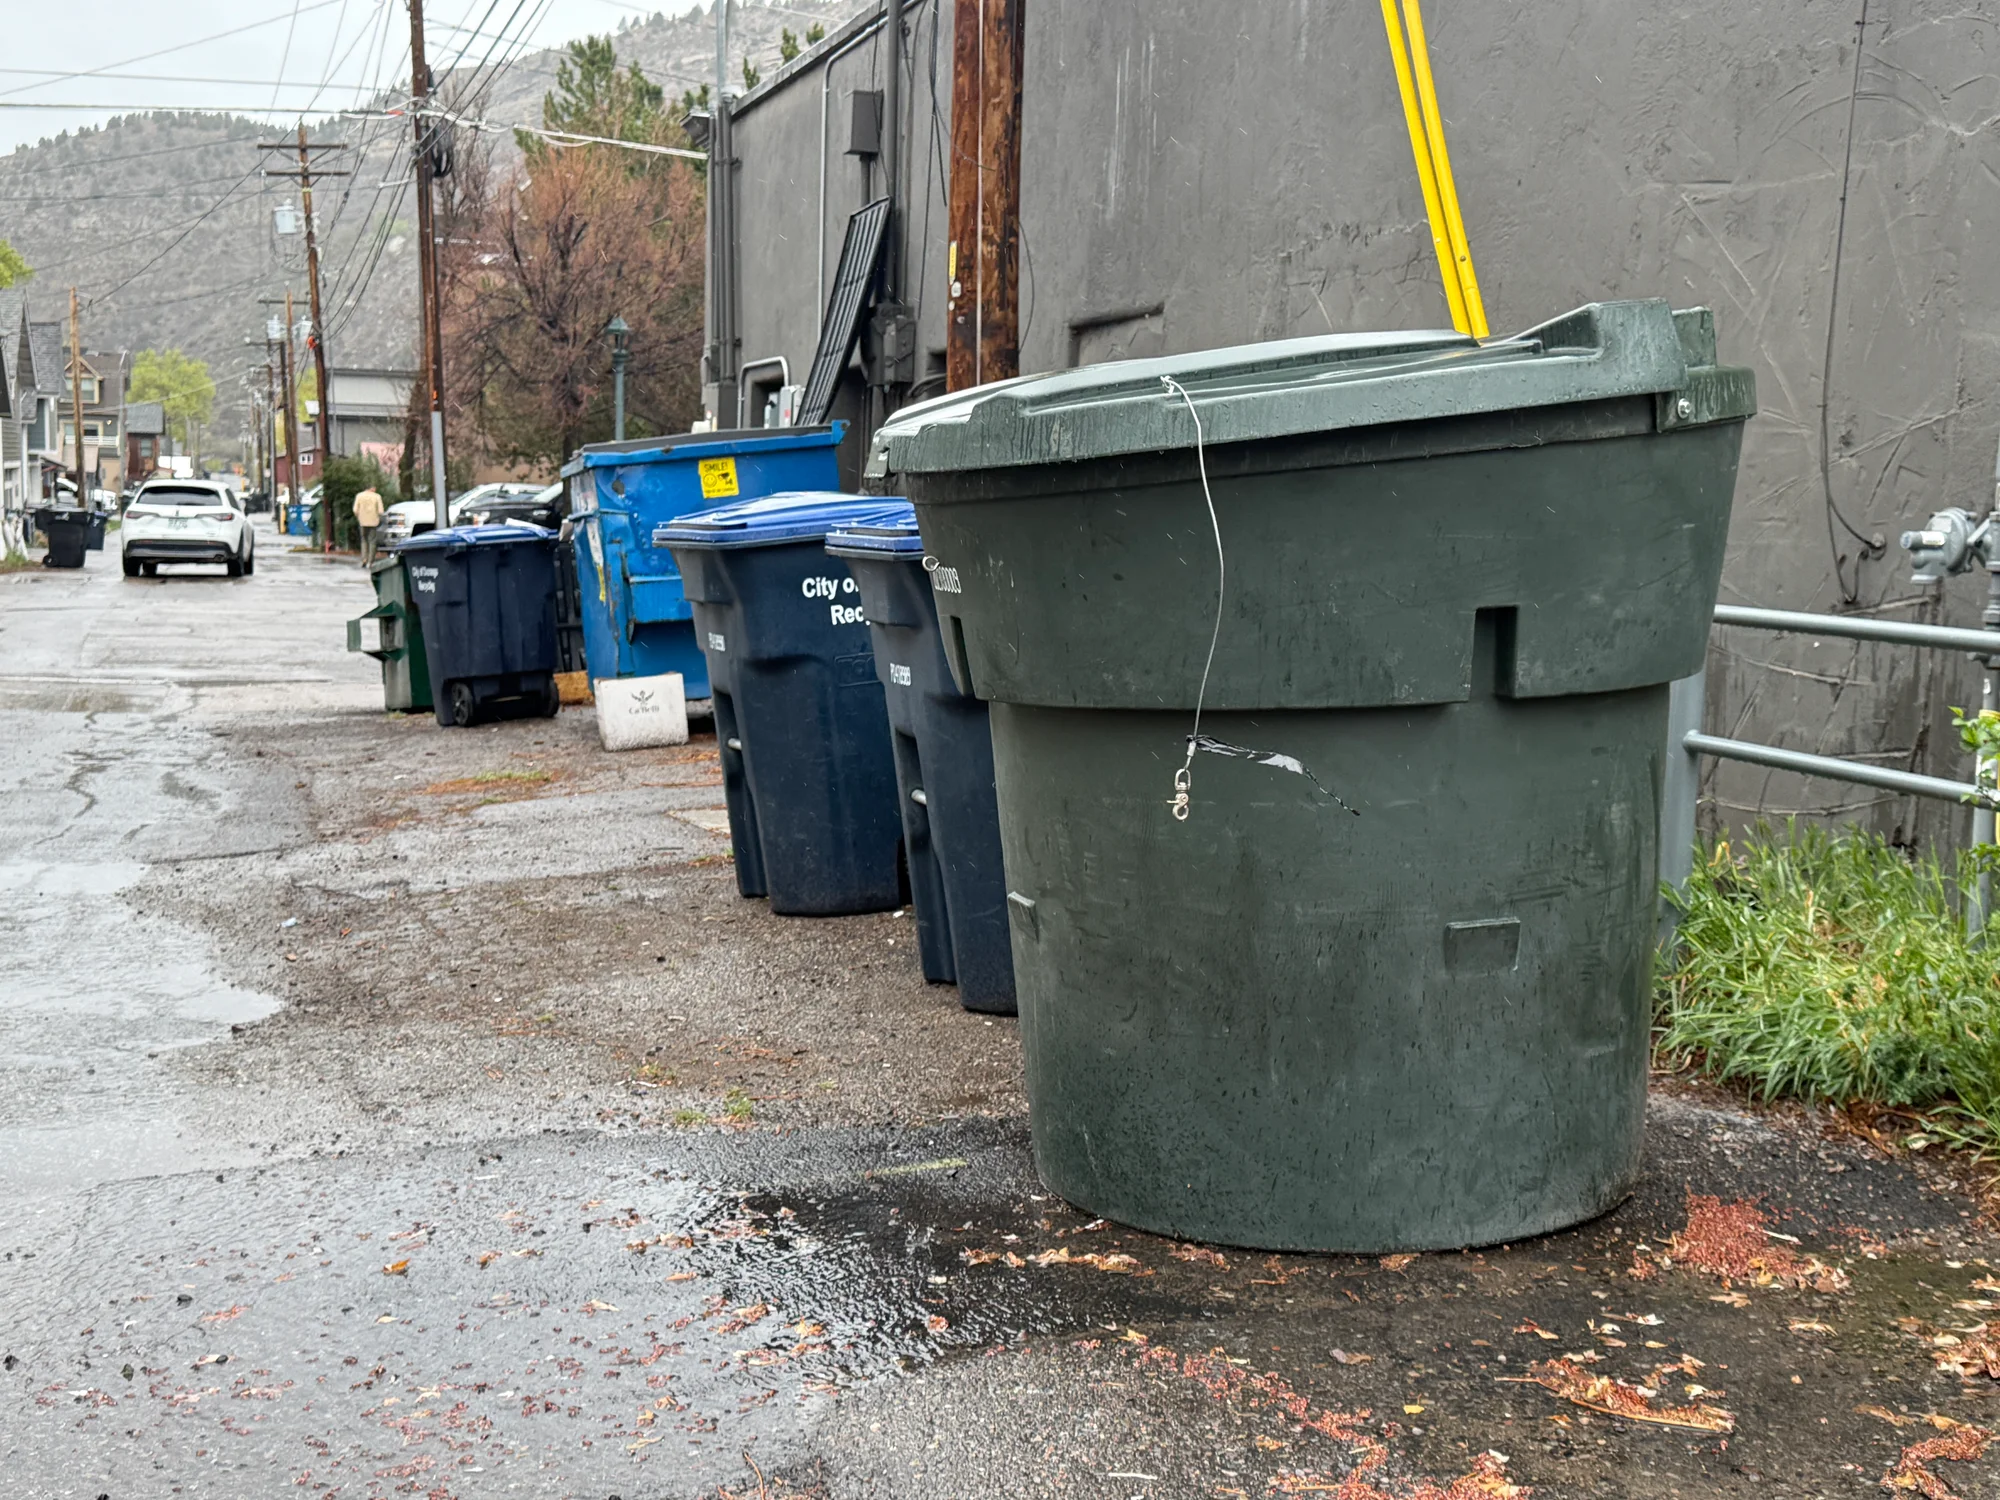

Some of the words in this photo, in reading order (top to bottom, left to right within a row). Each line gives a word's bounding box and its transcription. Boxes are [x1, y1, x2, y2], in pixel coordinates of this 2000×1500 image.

[704, 462, 729, 473] SMILE!
[802, 577, 839, 600] City
[830, 604, 871, 626] Rec
